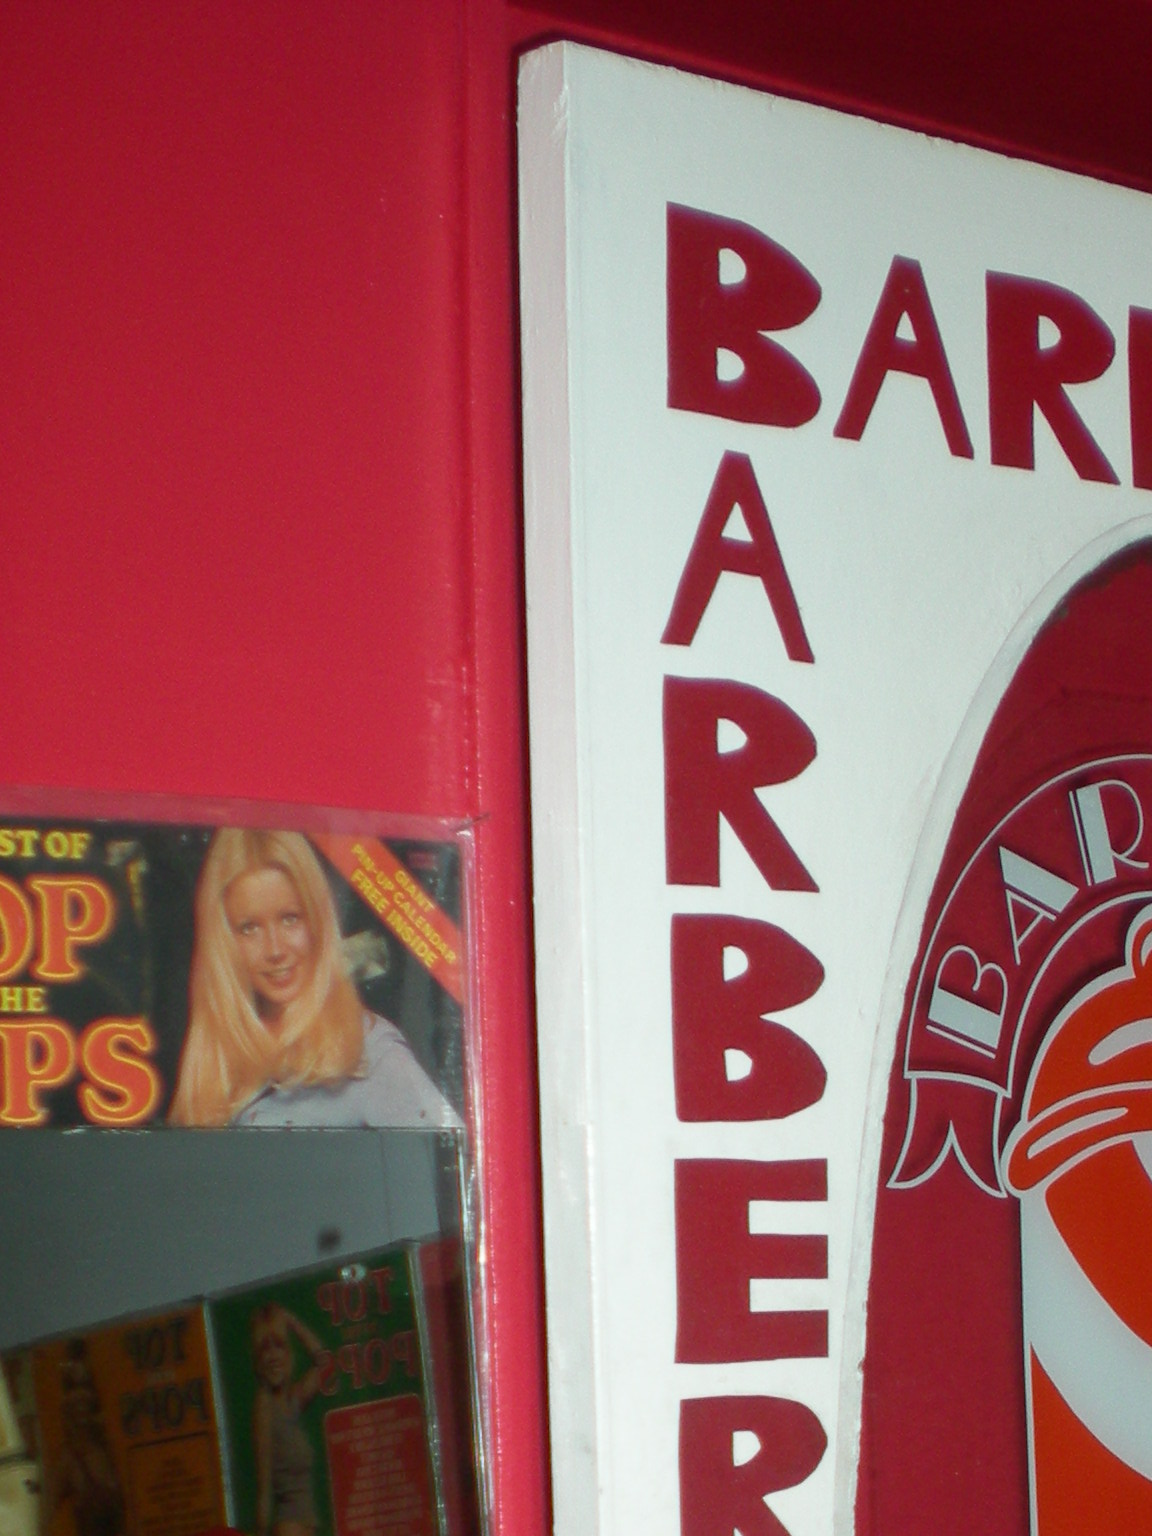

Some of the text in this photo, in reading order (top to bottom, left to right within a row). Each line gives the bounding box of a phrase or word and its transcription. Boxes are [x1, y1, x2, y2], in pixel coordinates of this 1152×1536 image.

[44, 831, 91, 859] OF
[350, 843, 457, 965] PIN-UP CALENDAR
[350, 868, 438, 968] FREE INSIDE
[394, 869, 435, 913] GIANT
